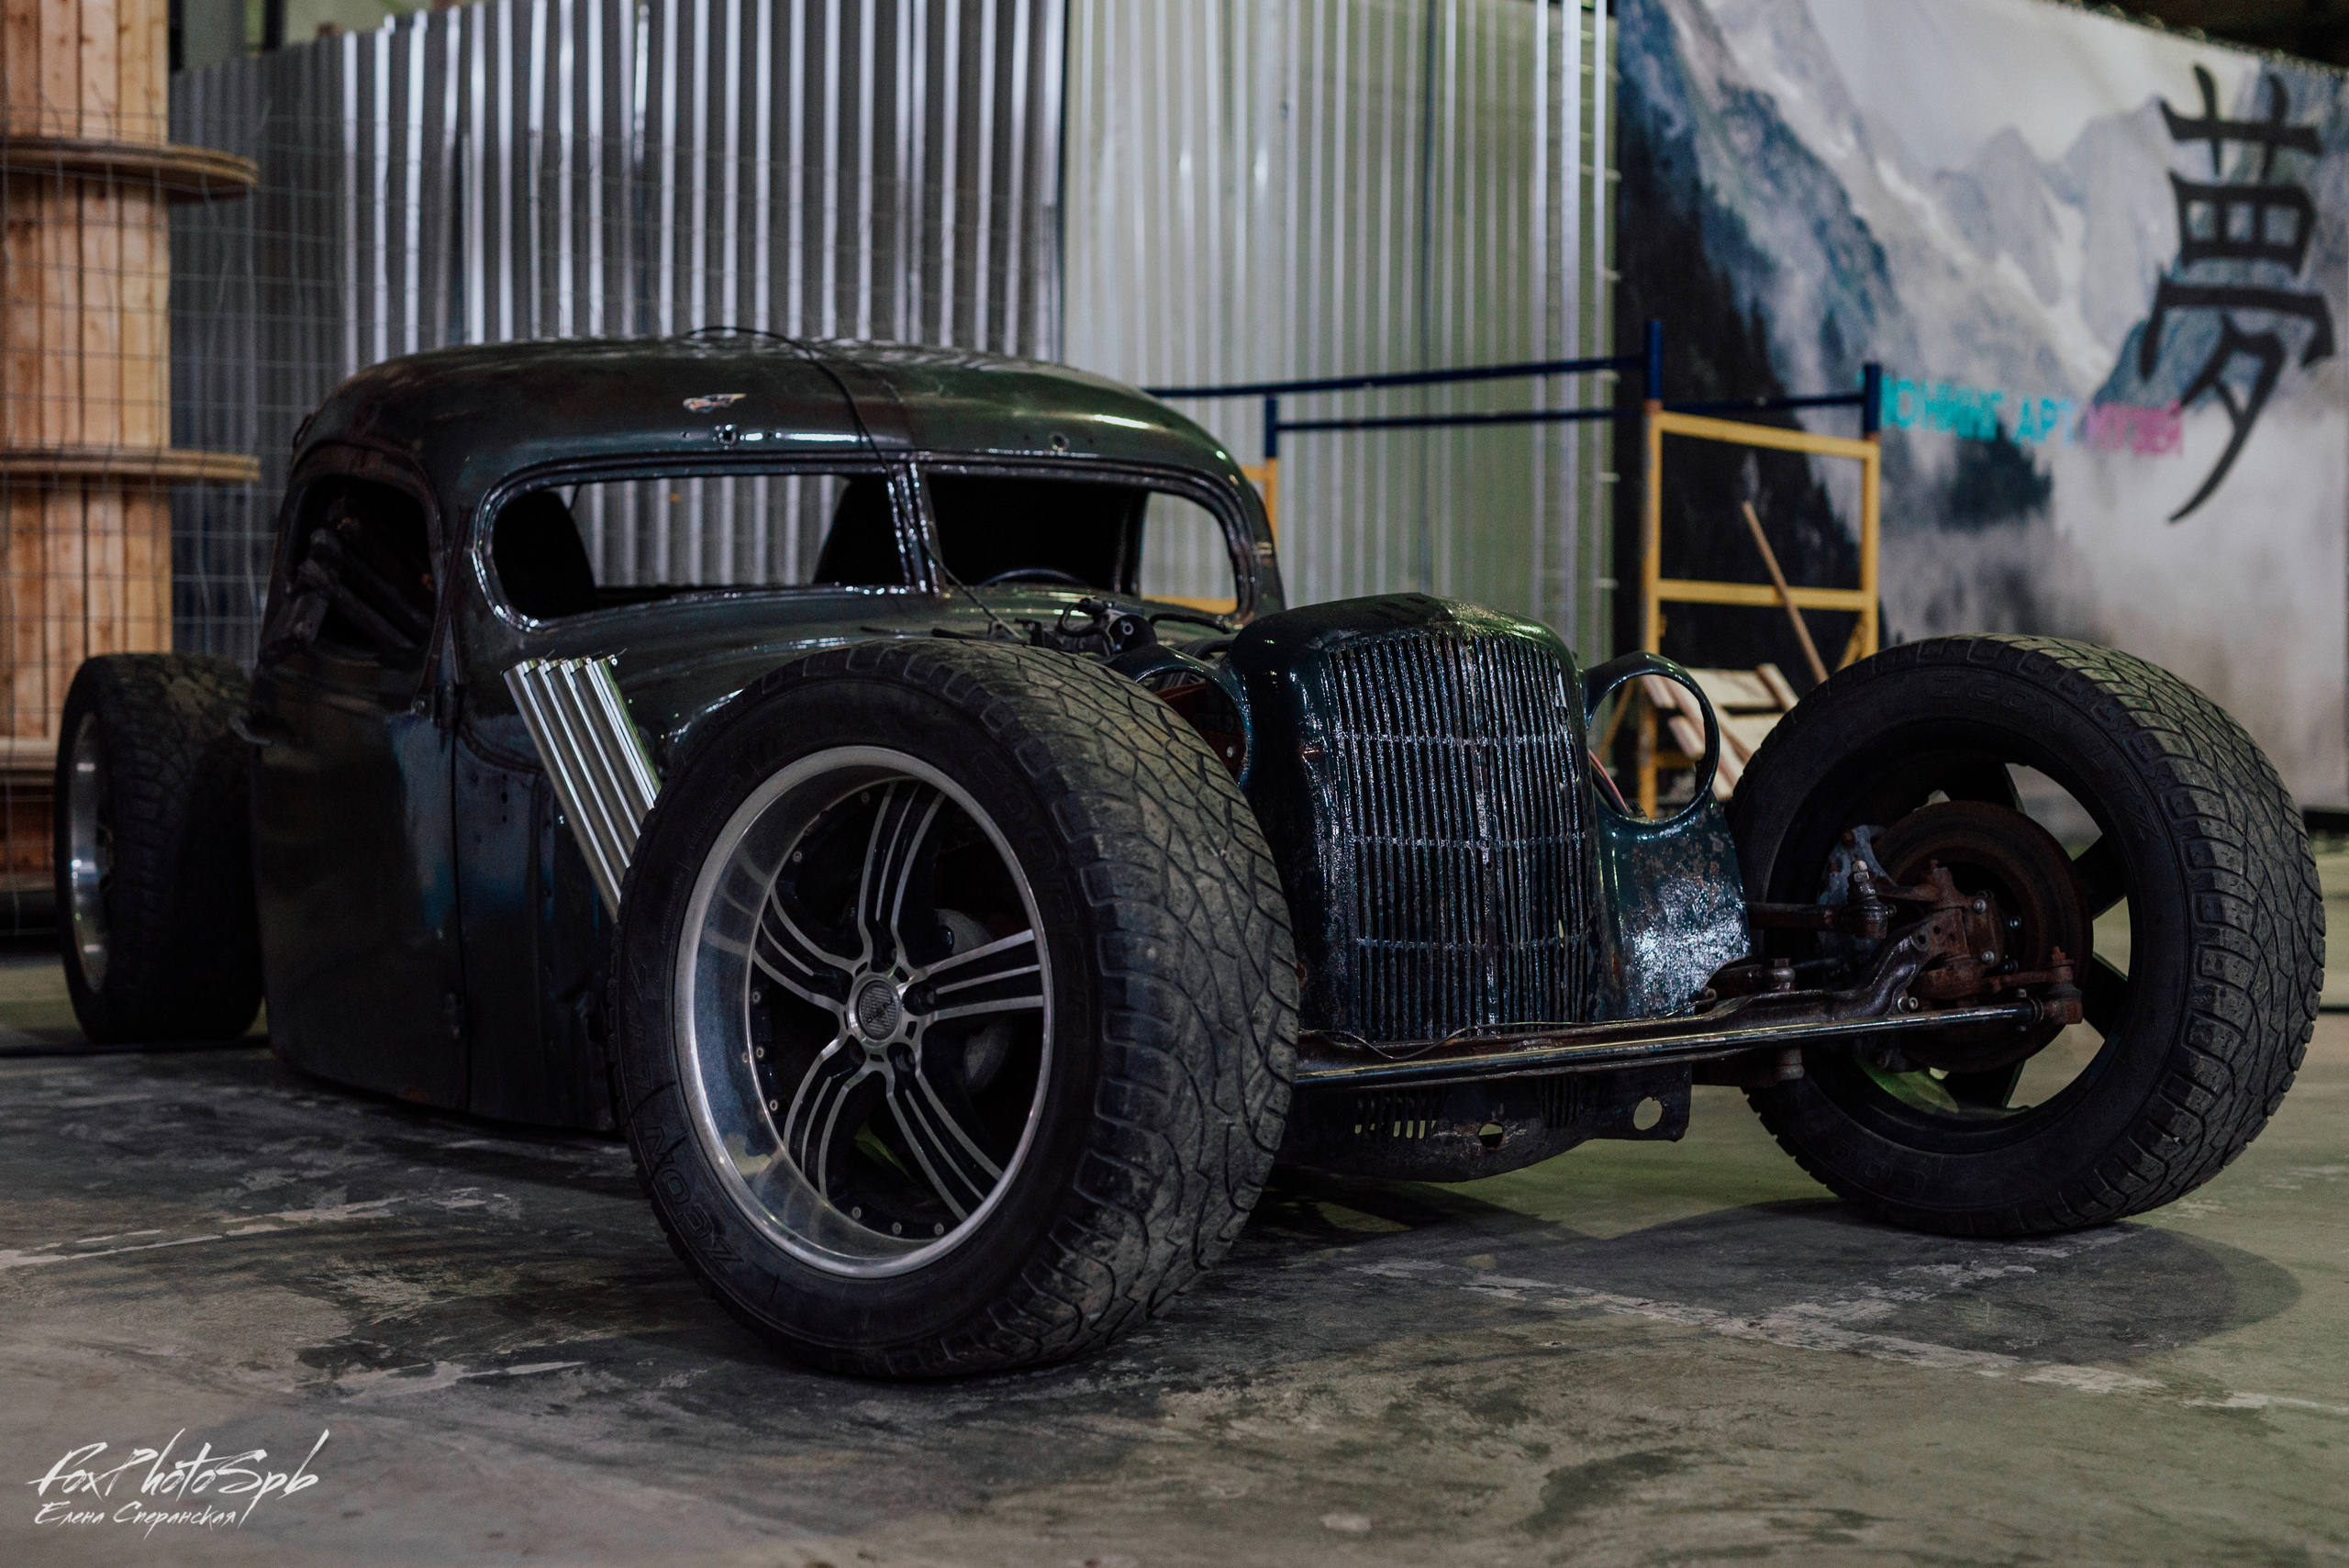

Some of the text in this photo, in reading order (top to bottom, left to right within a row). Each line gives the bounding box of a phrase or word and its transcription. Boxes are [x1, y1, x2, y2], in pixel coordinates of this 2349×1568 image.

[2141, 62, 2335, 524] 夢
[1854, 368, 2006, 442] ЮНИНГ
[643, 1124, 745, 1276] ZEON
